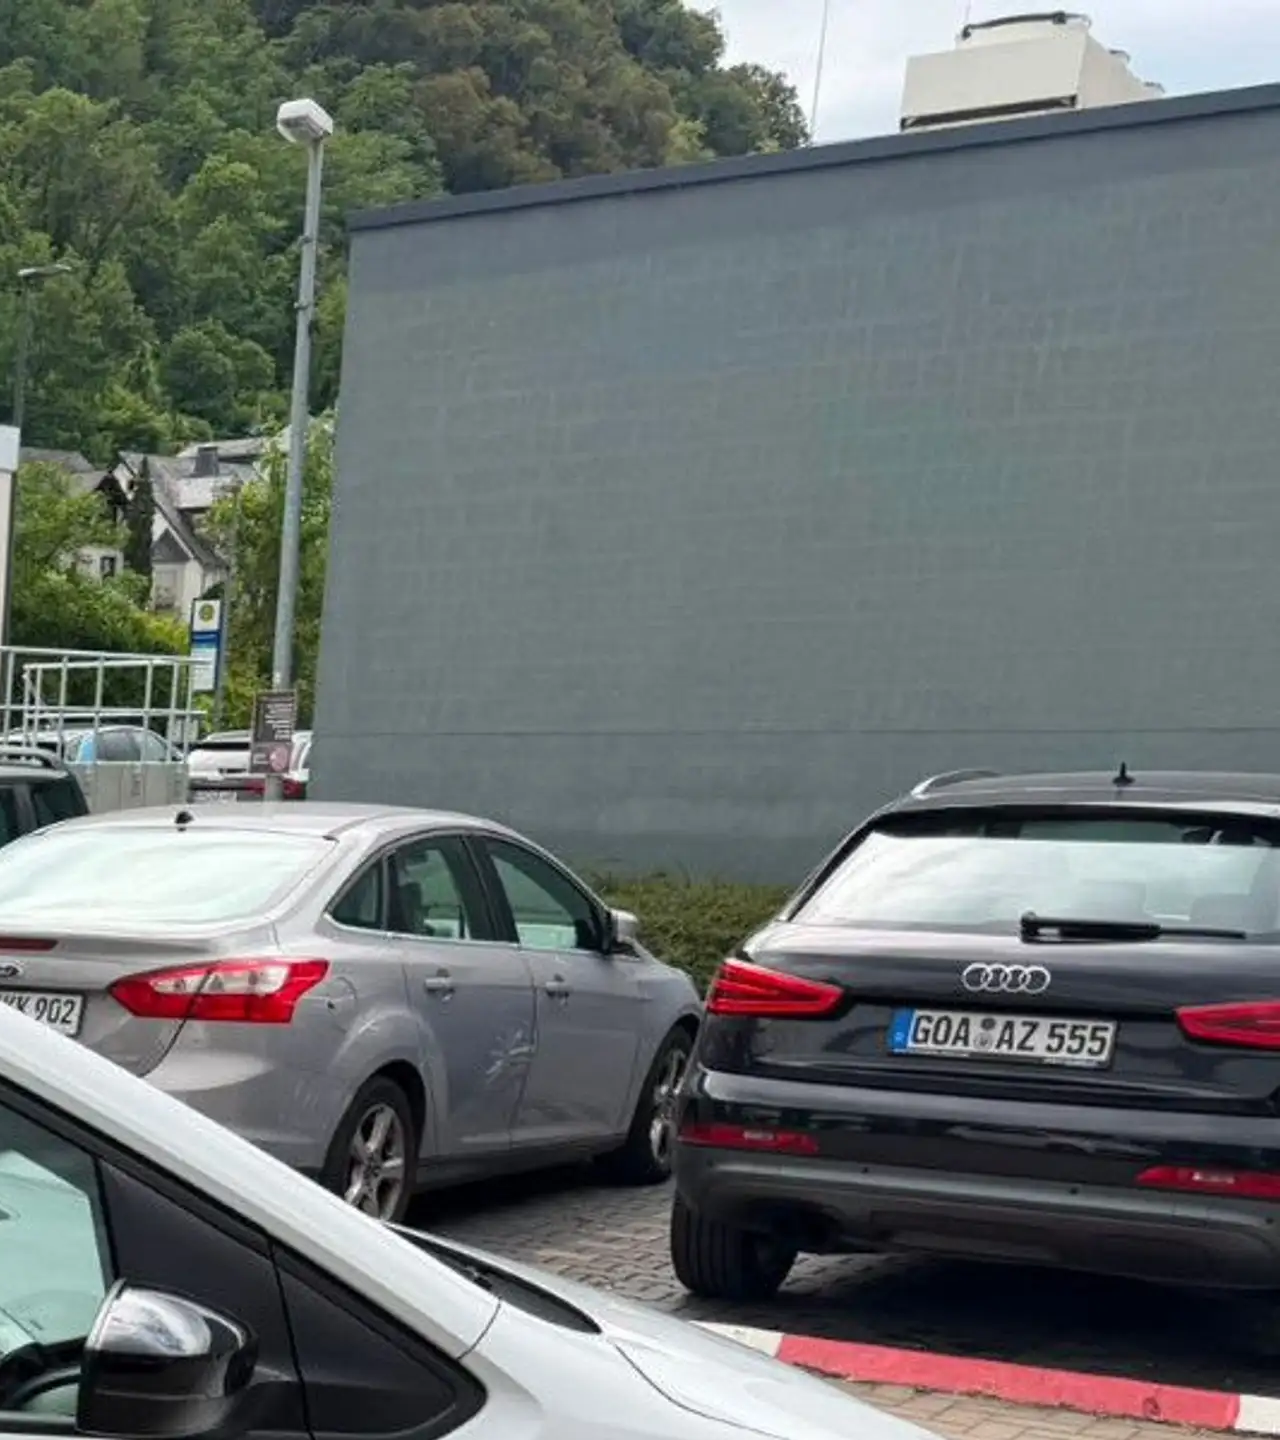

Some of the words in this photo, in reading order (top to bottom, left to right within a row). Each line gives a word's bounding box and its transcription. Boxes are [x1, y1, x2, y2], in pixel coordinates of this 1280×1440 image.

[35, 996, 76, 1025] 902
[912, 1014, 971, 1048] GOA
[996, 1019, 1041, 1053] AZ
[1045, 1022, 1110, 1058] 555
